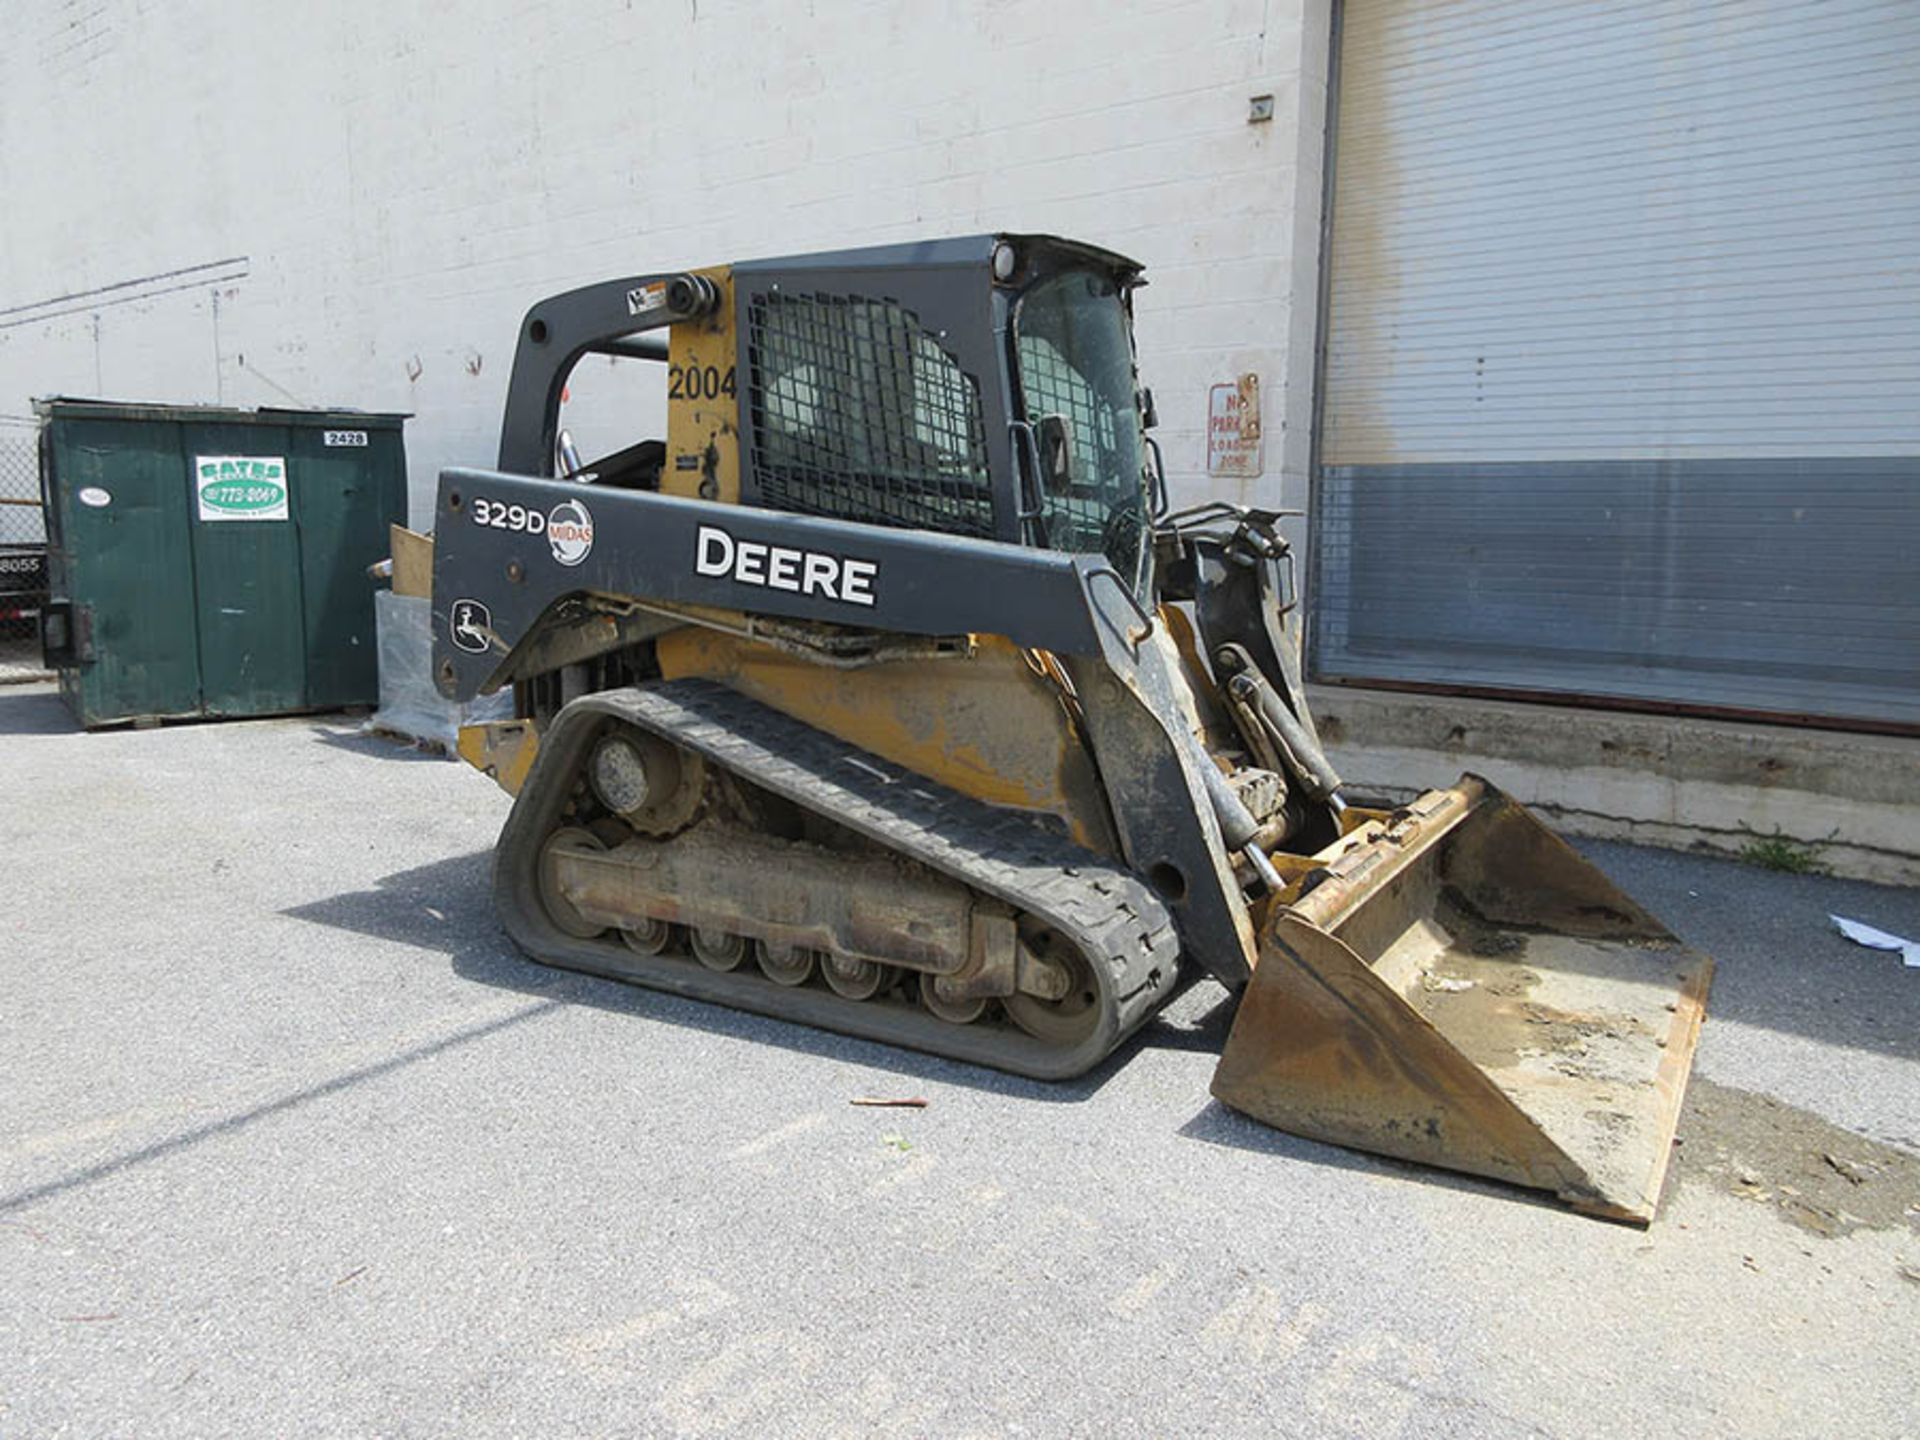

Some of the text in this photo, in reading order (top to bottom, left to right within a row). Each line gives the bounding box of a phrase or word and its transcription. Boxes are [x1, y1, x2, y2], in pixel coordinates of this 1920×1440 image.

[668, 365, 737, 400] 2004
[329, 431, 364, 446] 2428
[200, 460, 281, 479] BATES
[474, 499, 545, 534] 329D
[549, 525, 593, 543] MIDAS
[695, 526, 878, 606] DEERE
